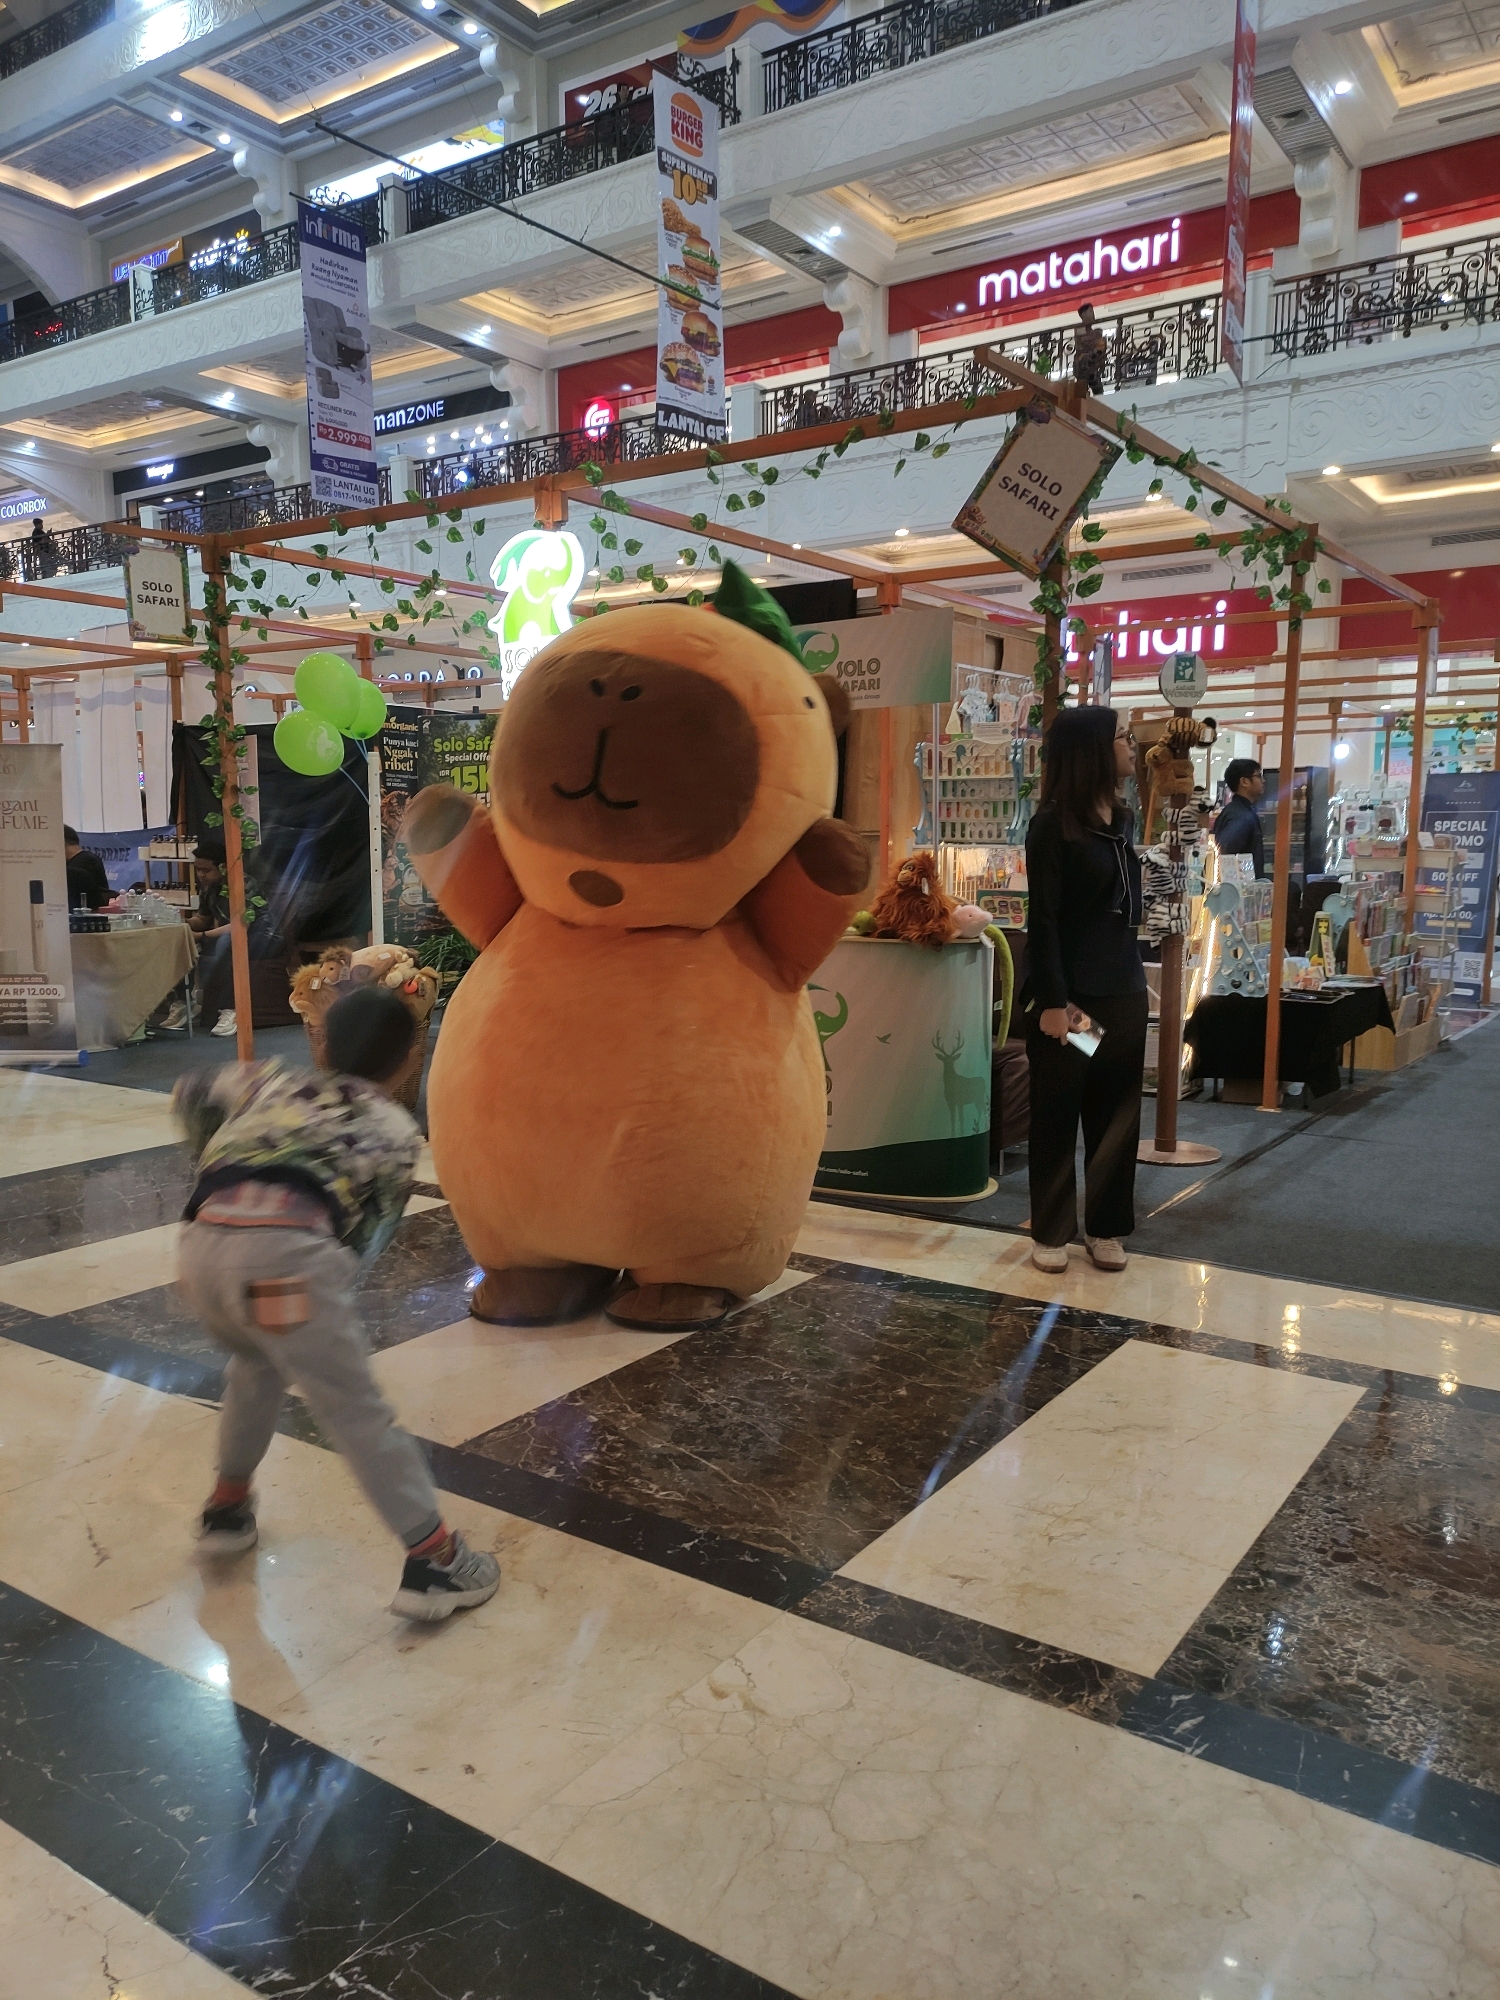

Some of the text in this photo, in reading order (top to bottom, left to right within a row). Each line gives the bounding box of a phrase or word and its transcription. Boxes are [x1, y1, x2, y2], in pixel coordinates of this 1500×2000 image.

[671, 105, 703, 133] BURGER
[671, 119, 703, 149] KING
[661, 151, 687, 173] SUPER
[686, 164, 713, 185] HEMAT
[672, 169, 697, 205] 10
[305, 214, 361, 254] informa
[320, 257, 349, 272] Hadirkan
[979, 218, 1181, 306] matahari
[311, 263, 331, 277] Ruang
[332, 270, 358, 284] Nyaman
[318, 402, 342, 414] RECLINER
[343, 409, 357, 417] SOFA
[374, 400, 444, 431] manZONE
[319, 425, 327, 434] Rp
[657, 410, 705, 438] LANTAI
[340, 461, 360, 471] GRATIS
[333, 479, 375, 495] LANTAI UG
[1017, 462, 1063, 497] SOLO
[333, 490, 376, 506] 0817-110-945
[998, 475, 1061, 521] SAFARI
[1, 497, 47, 519] COLORBOX
[142, 581, 173, 593] SOLO
[137, 594, 180, 608] SAFARI
[836, 657, 881, 678] SOLO
[843, 678, 881, 694] AFARI
[383, 736, 405, 747] Punya
[434, 736, 492, 753] Solo Saf
[383, 746, 413, 760] Nggak
[445, 752, 491, 763] Special Offe
[384, 759, 414, 771] ribet!
[0, 800, 39, 815] gant
[0, 816, 48, 830] FUME
[1434, 820, 1488, 832] SPECIAL
[1455, 835, 1484, 846] OMO
[1456, 872, 1479, 882] OFF
[13, 988, 25, 996] RP
[27, 988, 61, 997] 12.000,
